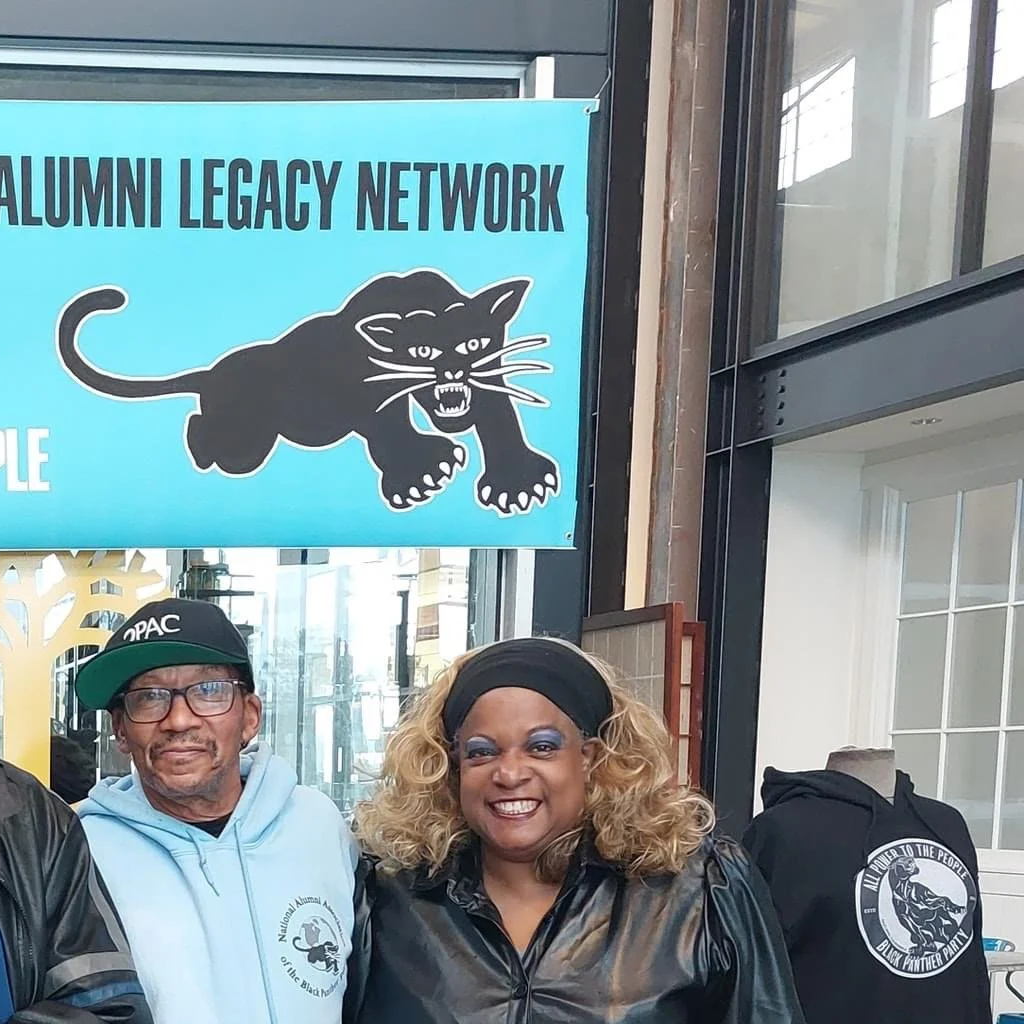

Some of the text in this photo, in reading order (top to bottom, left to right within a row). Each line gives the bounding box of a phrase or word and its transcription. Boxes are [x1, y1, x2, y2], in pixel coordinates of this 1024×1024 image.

[179, 158, 343, 231] LEGACY
[356, 161, 565, 233] NETWORK
[863, 843, 969, 892] ALL POWER TO THE PEOPLE
[278, 903, 296, 942] National
[295, 895, 322, 908] Alumni
[876, 929, 969, 973] BLACK PANTHER PARTY
[280, 956, 292, 967] of
[287, 967, 301, 983] the
[300, 980, 320, 998] Black
